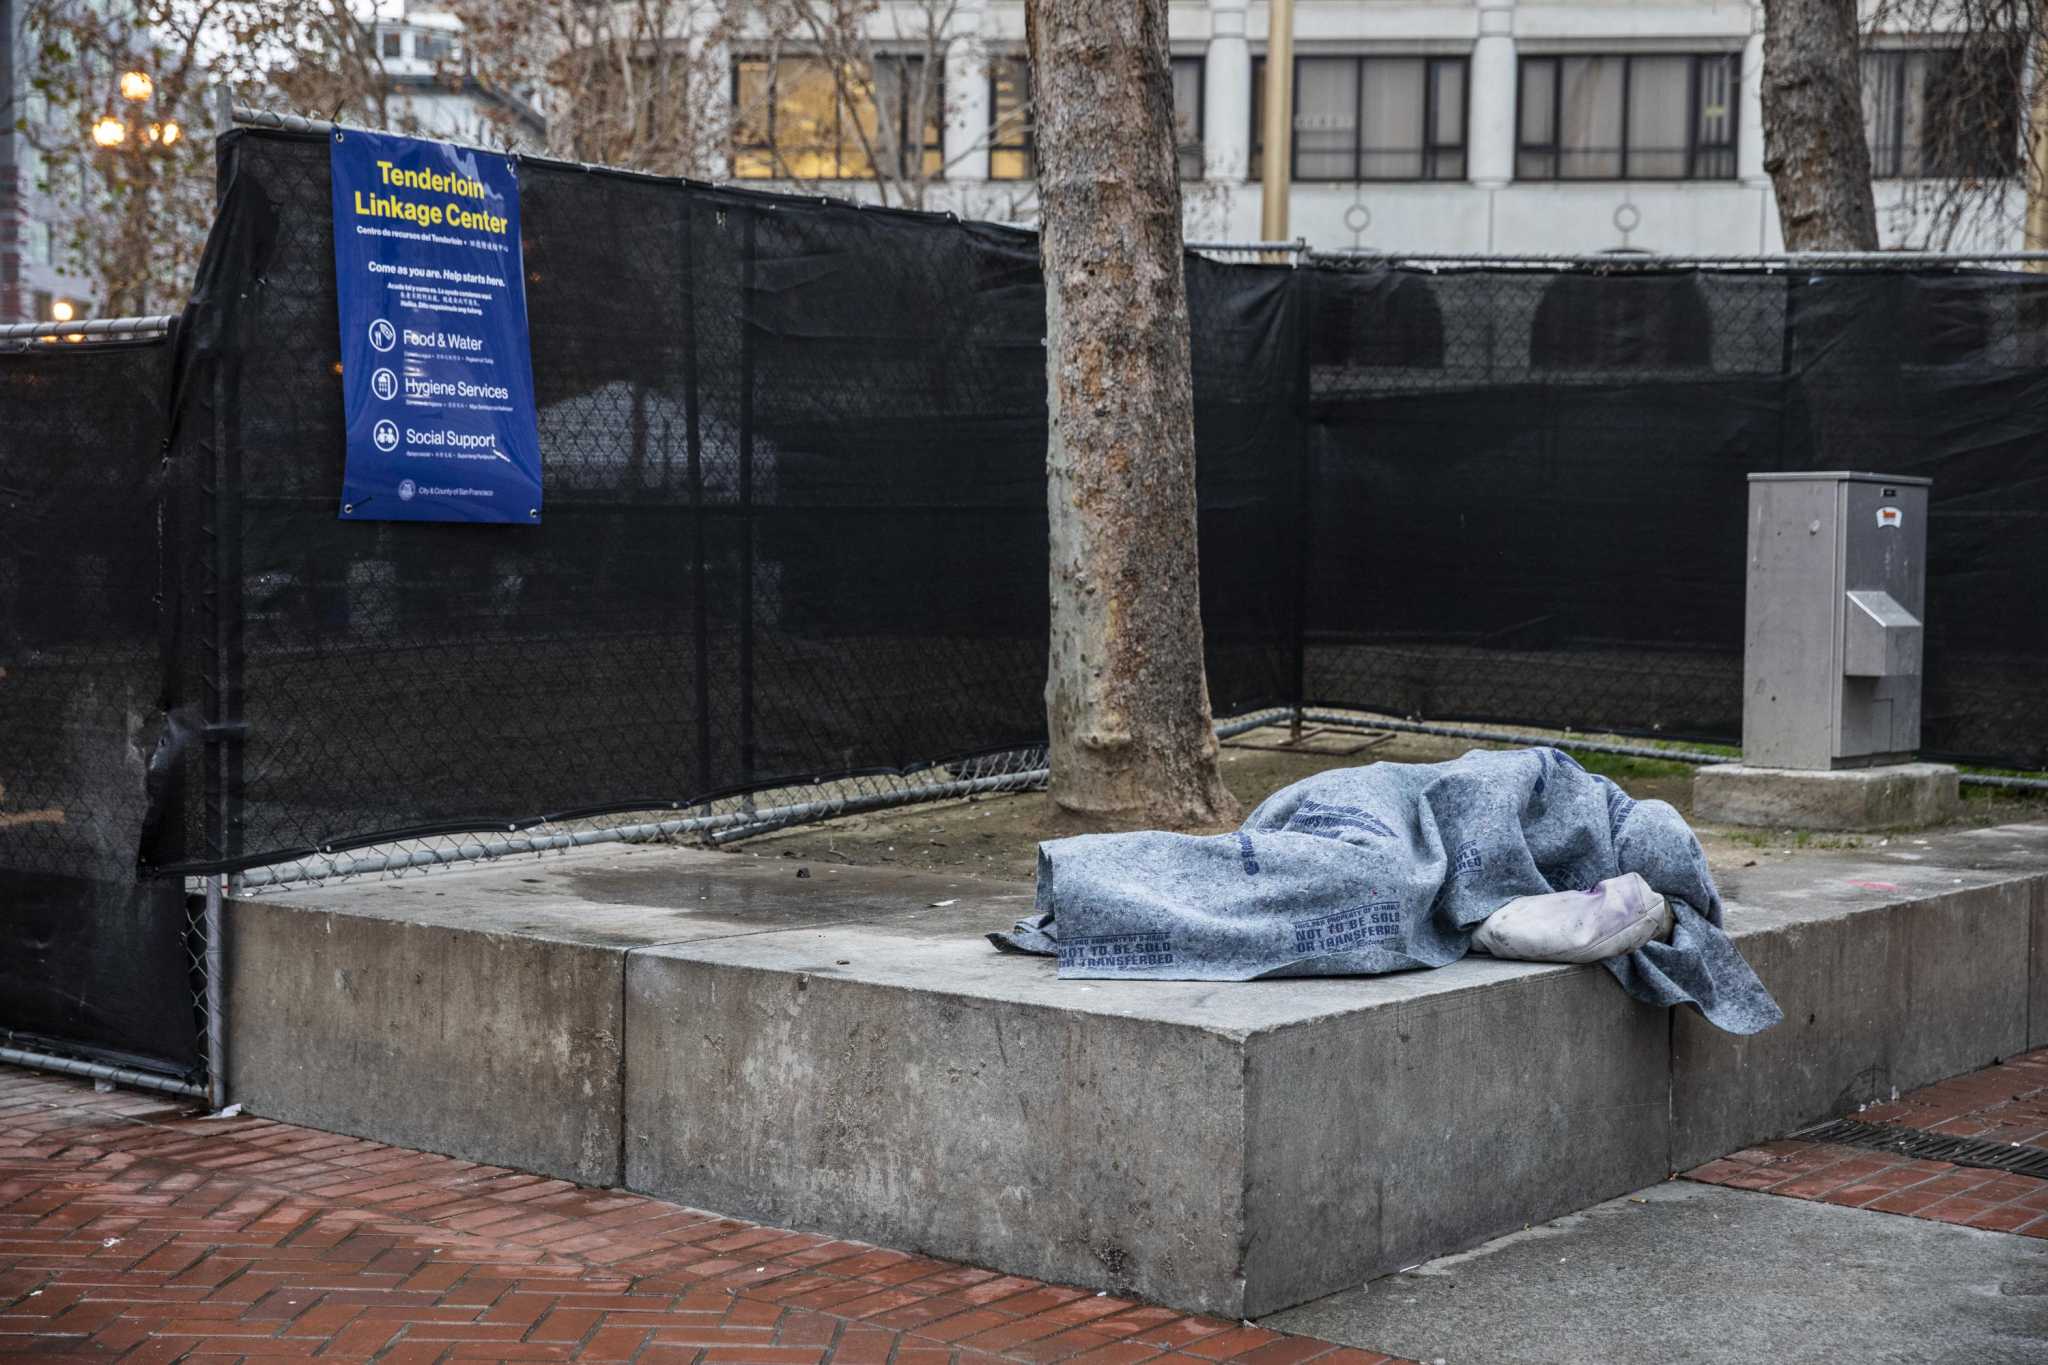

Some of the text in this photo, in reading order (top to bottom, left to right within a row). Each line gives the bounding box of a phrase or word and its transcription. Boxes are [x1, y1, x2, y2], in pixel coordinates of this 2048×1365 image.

[377, 160, 485, 199] Tenderloin
[355, 191, 508, 234] Linkage Center
[432, 234, 463, 246] Tenderloin
[368, 261, 505, 287] Come as you are. Help starts here.
[403, 329, 482, 351] Food & Water
[405, 377, 509, 400] Hygiene Services
[406, 428, 496, 449] Social Support
[1295, 912, 1400, 941] NOT TO BE SOLD
[1091, 945, 1108, 956] TO
[1113, 943, 1131, 954] BE
[1136, 942, 1171, 953] SOLD
[1296, 925, 1399, 953] OR TRANSFERRED
